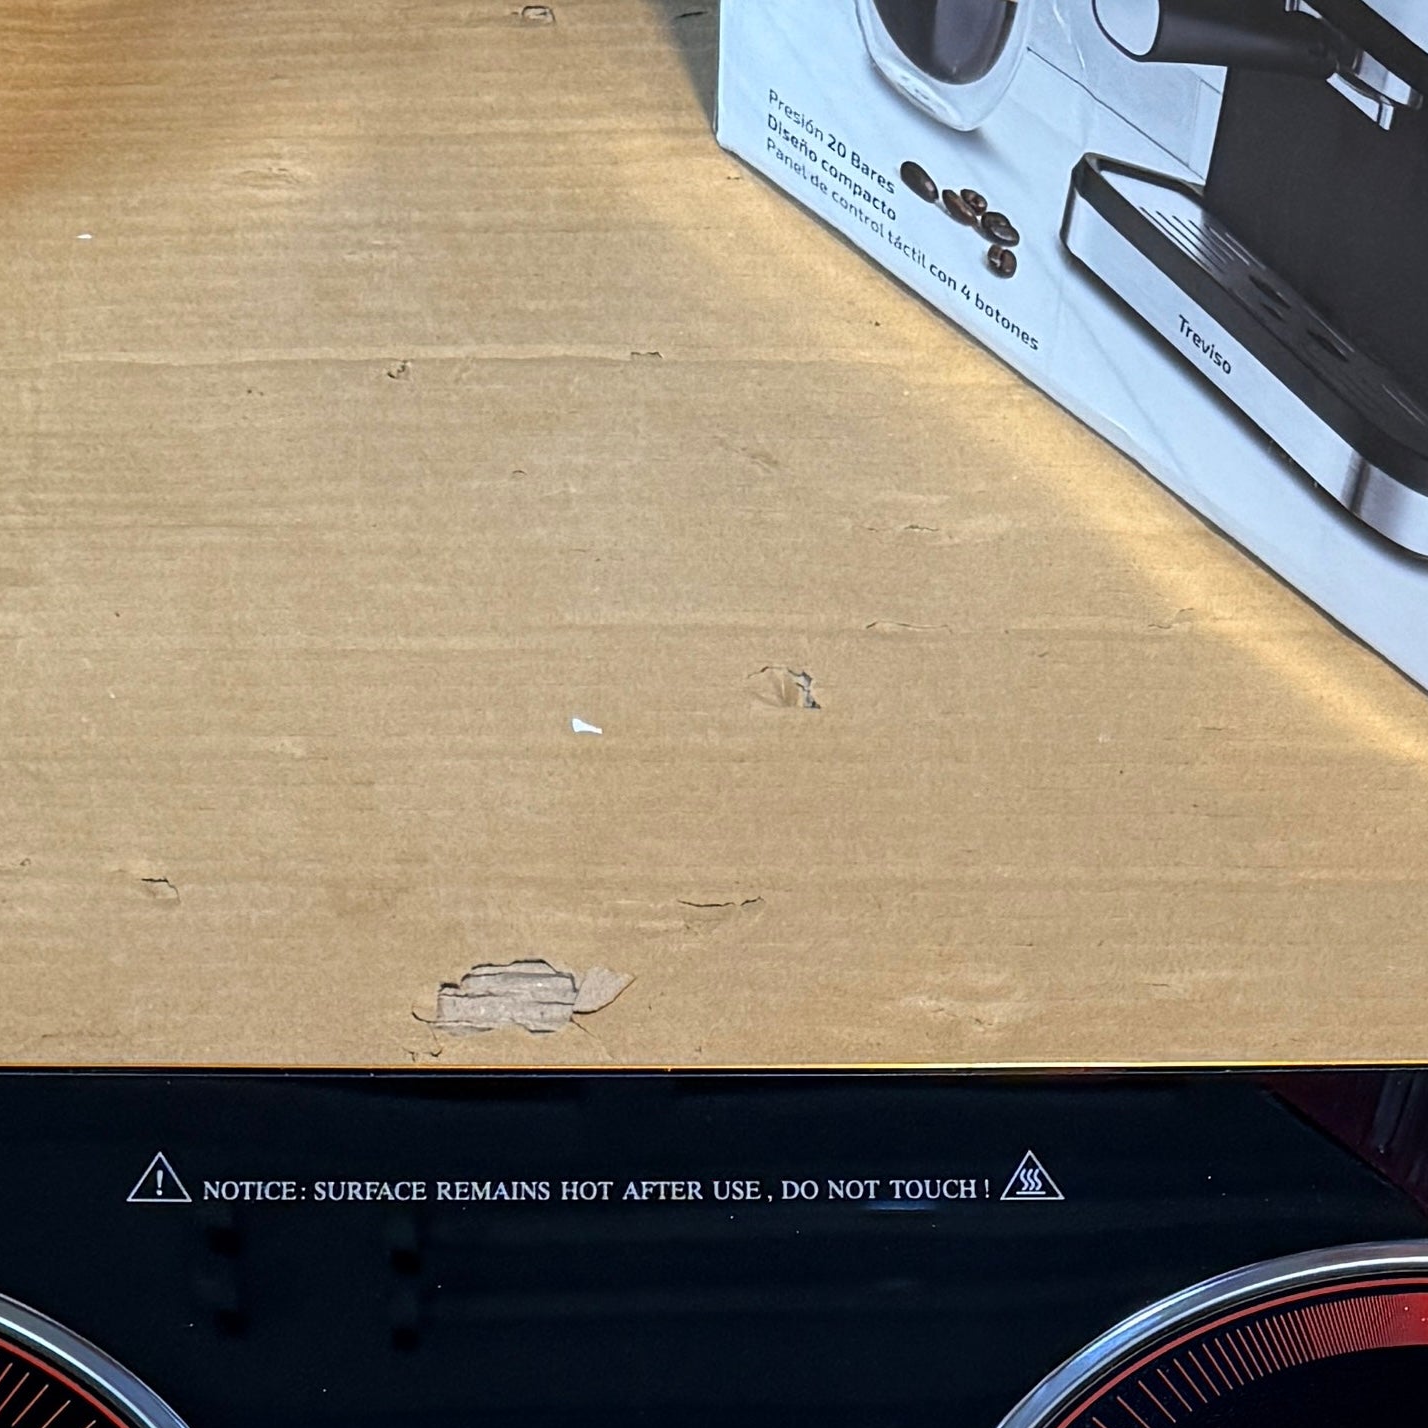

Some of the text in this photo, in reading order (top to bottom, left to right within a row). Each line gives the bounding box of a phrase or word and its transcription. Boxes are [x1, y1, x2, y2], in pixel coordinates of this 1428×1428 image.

[767, 113, 897, 221] Diseño compacto
[768, 88, 895, 195] Presión 20 Bares
[766, 136, 1039, 351] Panel de control táctil con 4 botones
[1176, 313, 1233, 376] Treviso
[203, 1181, 306, 1201] NOTICE:
[314, 1181, 427, 1201] SURFACE
[436, 1181, 550, 1201] REMAINS
[561, 1181, 614, 1201] HOT
[622, 1181, 704, 1200] AFTER
[781, 1180, 819, 1200] DO
[827, 1179, 880, 1199] NOT
